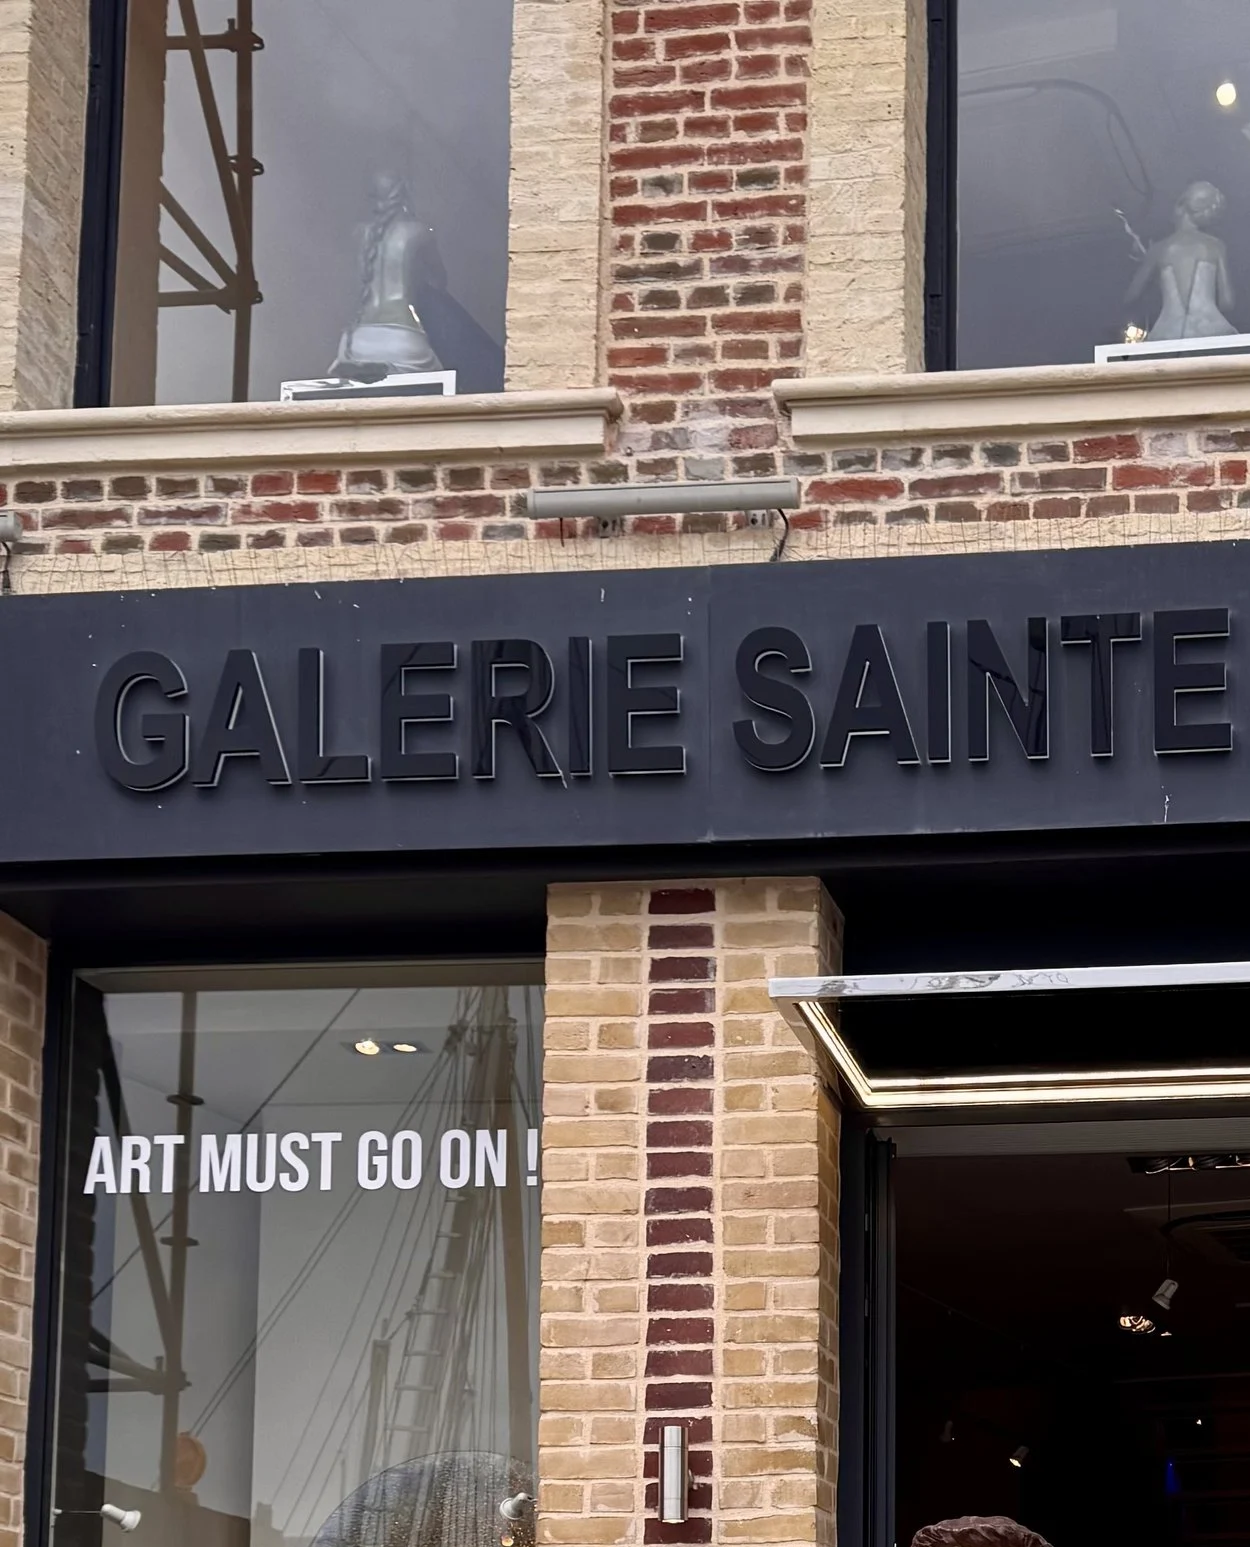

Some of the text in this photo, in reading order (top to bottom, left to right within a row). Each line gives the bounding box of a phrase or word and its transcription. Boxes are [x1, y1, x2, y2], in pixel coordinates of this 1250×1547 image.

[94, 632, 686, 792] GALERIE
[732, 607, 1233, 772] SAINTE
[83, 1135, 185, 1194] ART
[199, 1132, 342, 1193] MUST
[357, 1130, 423, 1190] GO
[440, 1129, 507, 1188] ON
